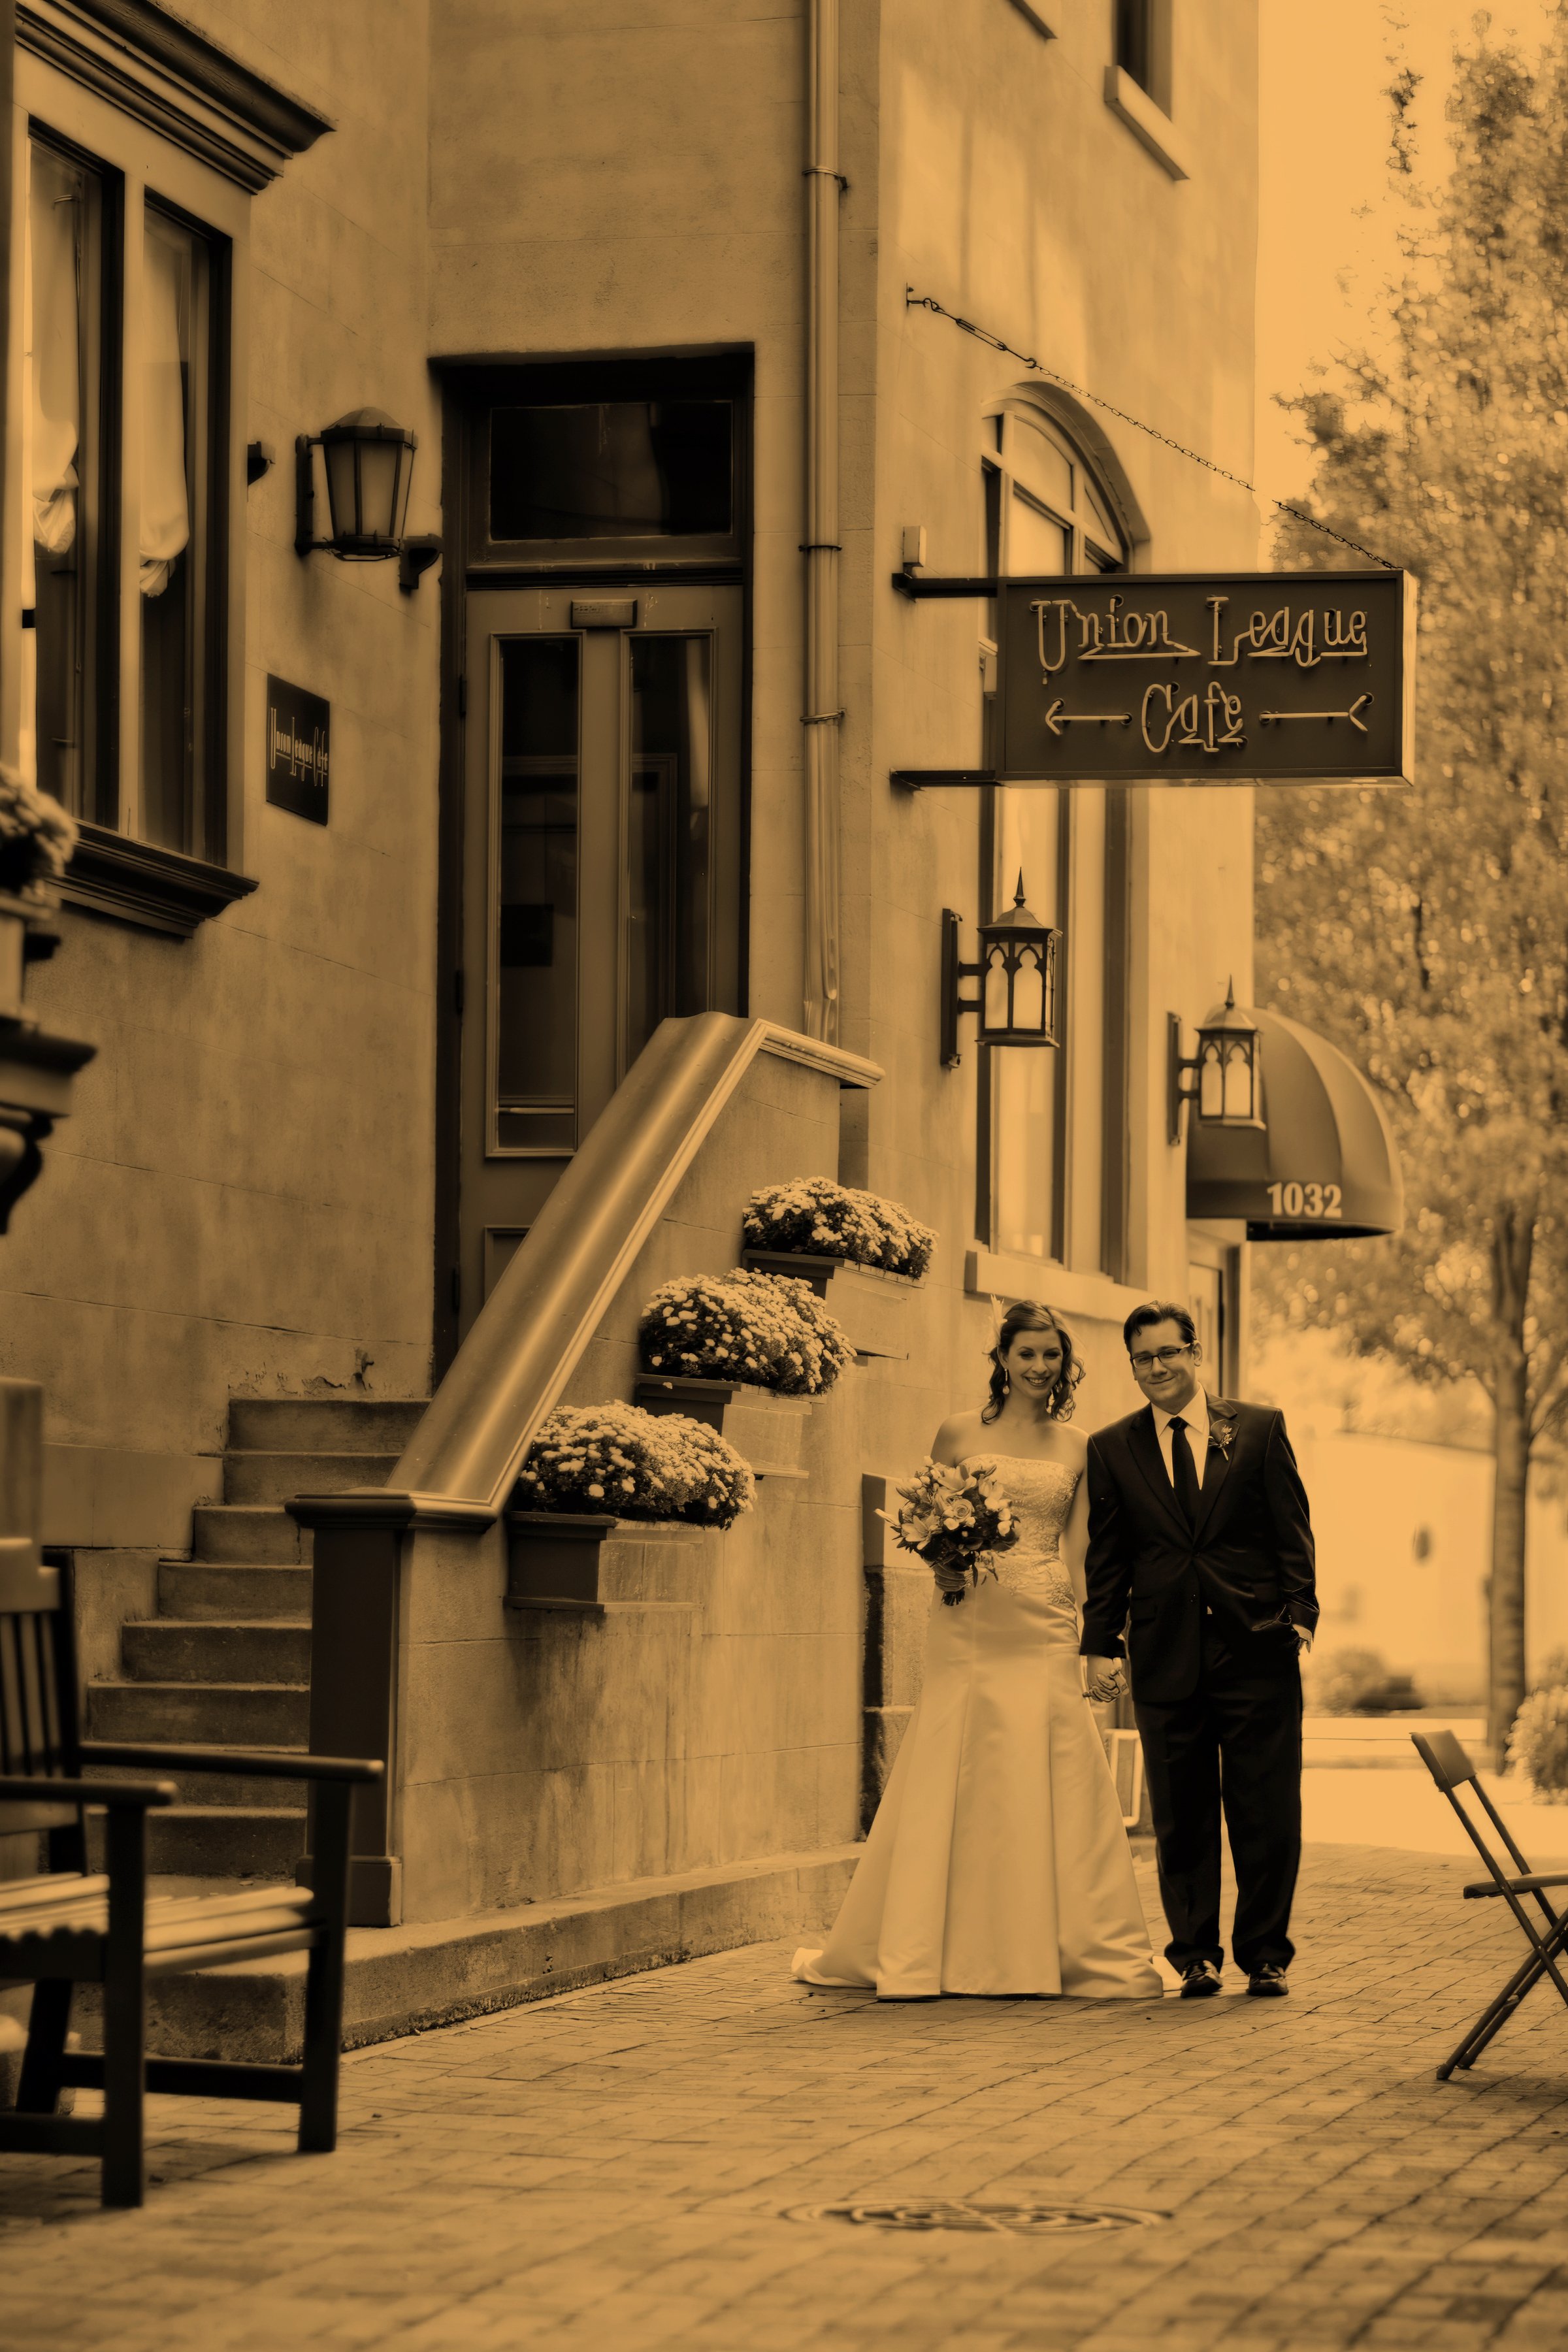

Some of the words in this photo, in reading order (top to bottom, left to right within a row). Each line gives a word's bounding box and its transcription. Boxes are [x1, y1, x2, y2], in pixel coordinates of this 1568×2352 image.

[1030, 598, 1201, 671] Union
[1207, 596, 1367, 667] League
[1266, 1181, 1342, 1218] 1032
